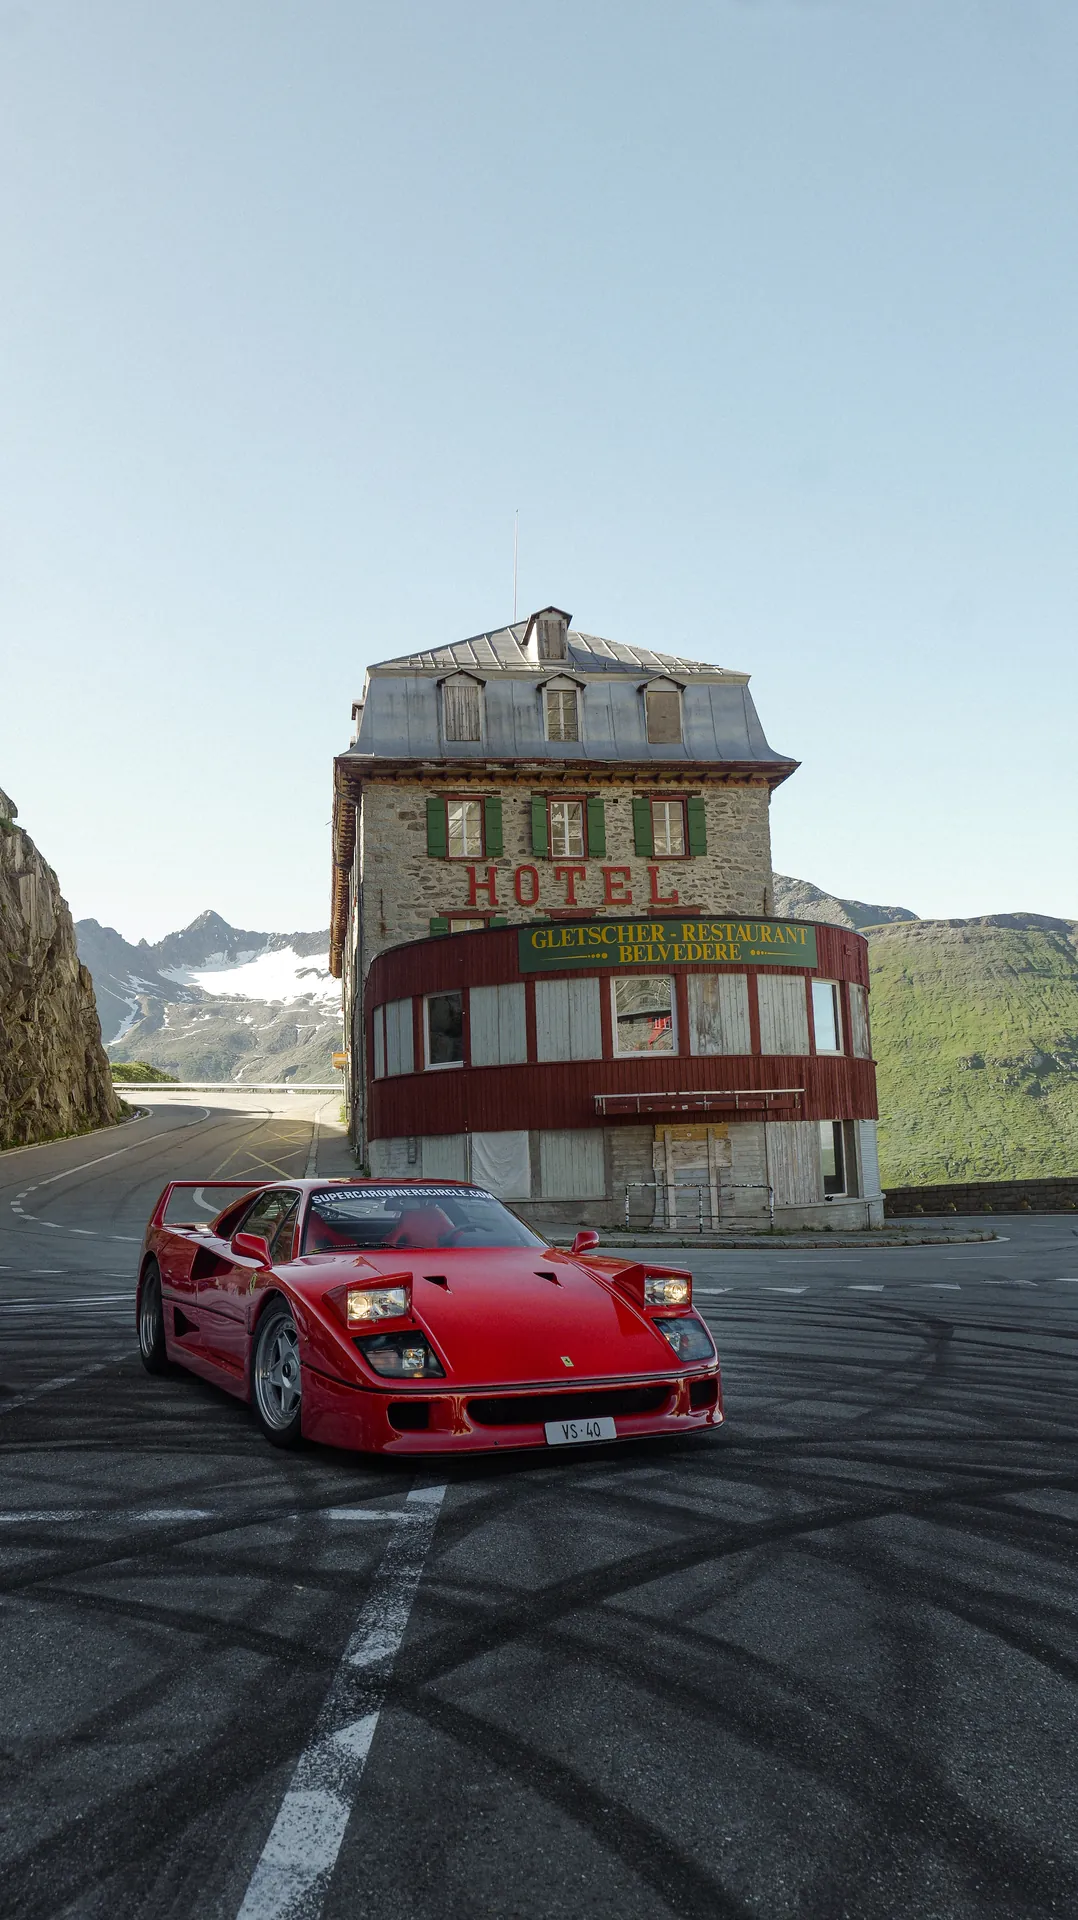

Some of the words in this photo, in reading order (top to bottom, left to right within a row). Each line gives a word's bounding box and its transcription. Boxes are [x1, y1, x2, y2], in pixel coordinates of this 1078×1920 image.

[466, 865, 679, 906] HOTEL
[531, 924, 666, 949] GLETSCHER
[681, 923, 808, 945] RESTAURANT
[617, 943, 742, 963] BELVEDERE
[312, 1188, 496, 1204] SUPERCAROWNERSCIRCLE.COM
